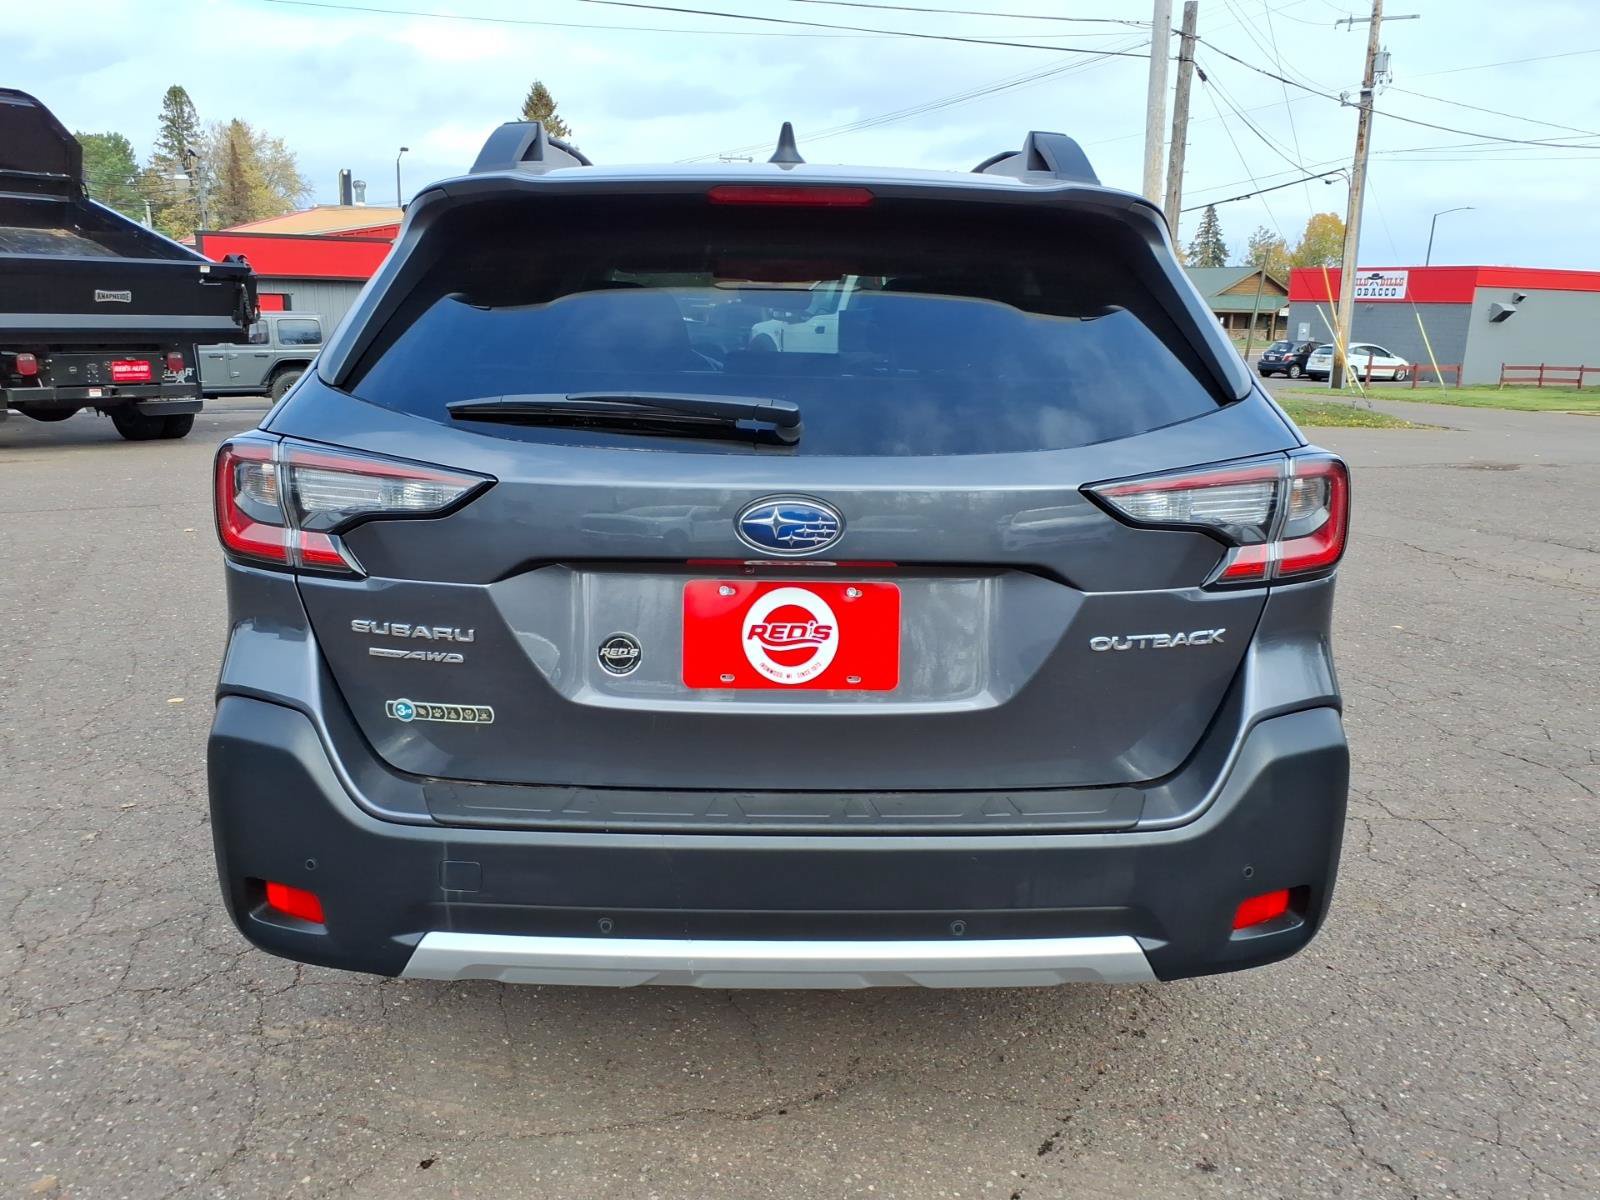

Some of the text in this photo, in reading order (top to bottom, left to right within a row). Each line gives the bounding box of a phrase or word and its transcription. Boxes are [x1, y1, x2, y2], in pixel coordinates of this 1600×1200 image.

[1356, 287, 1398, 297] OBACCO
[351, 619, 475, 642] SUBARU
[747, 621, 833, 644] RED'S
[1089, 628, 1226, 652] OUTBACK
[403, 650, 464, 663] AWD
[600, 647, 639, 659] RED'S
[396, 704, 412, 716] 3rd
